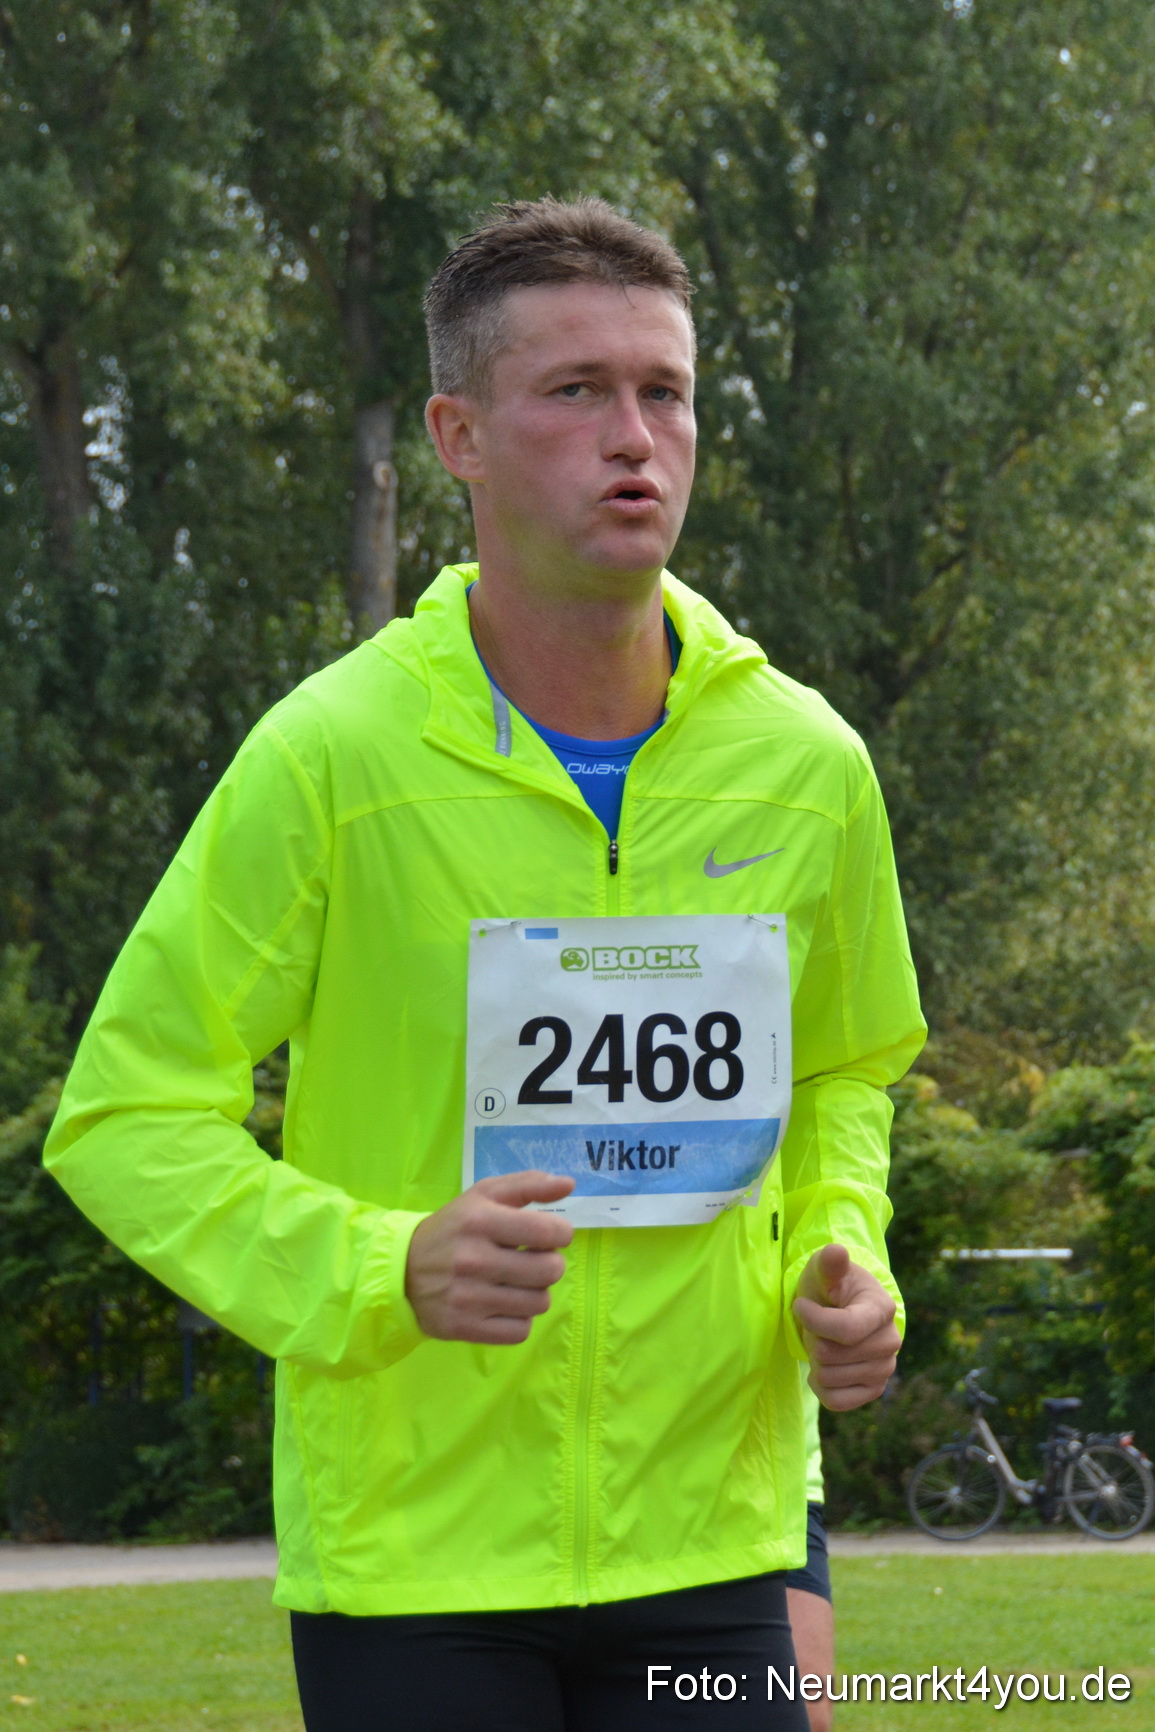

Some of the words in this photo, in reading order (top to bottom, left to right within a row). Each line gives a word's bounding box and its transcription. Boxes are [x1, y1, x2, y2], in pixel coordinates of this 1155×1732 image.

[592, 945, 701, 971] BOCK
[593, 973, 625, 982] inspired
[627, 973, 638, 981] by
[665, 971, 703, 980] concepts
[517, 1011, 744, 1105] 2468
[484, 1096, 495, 1112] D
[585, 1140, 681, 1172] Viktor
